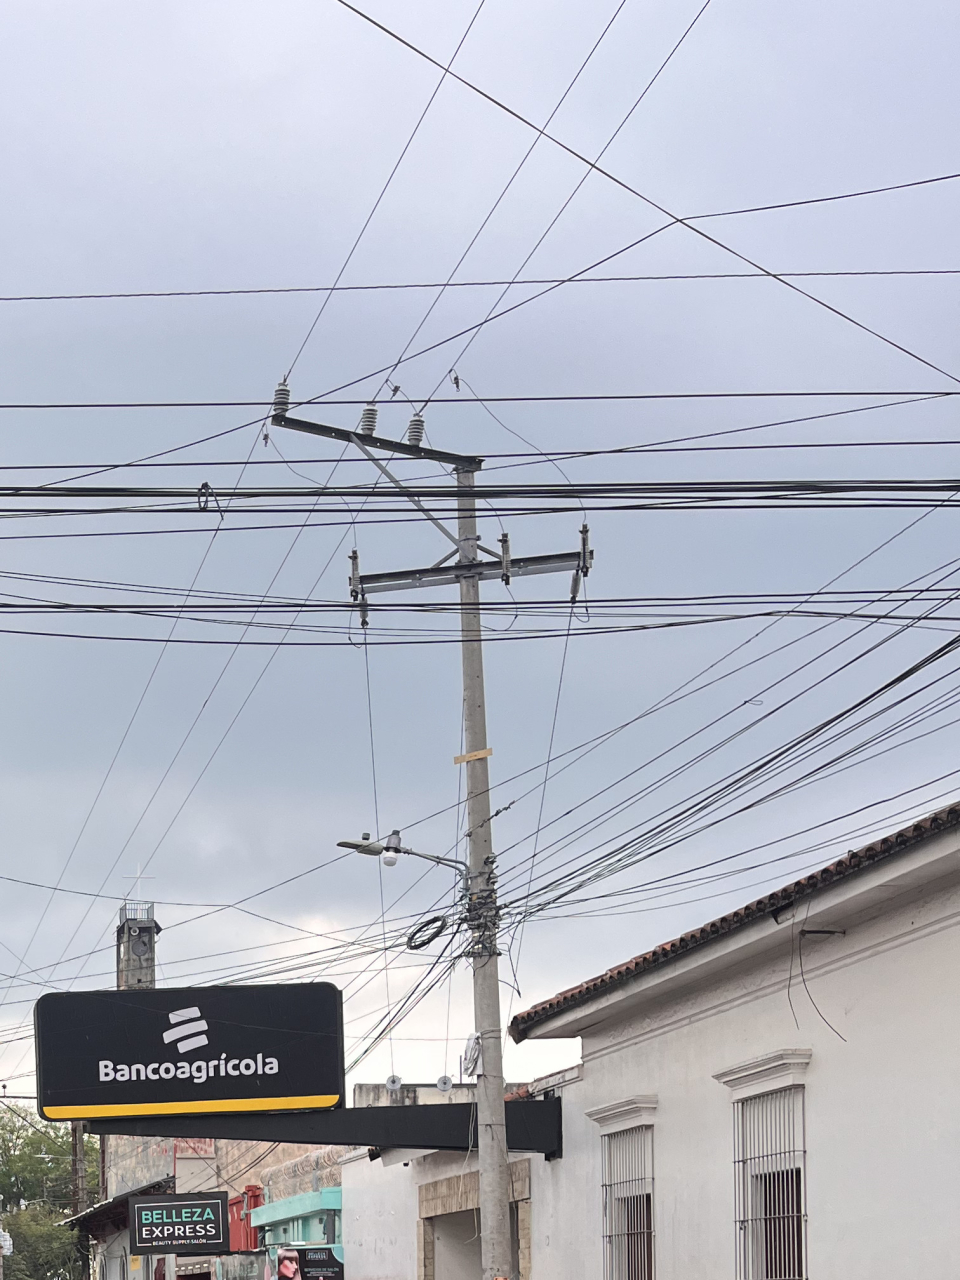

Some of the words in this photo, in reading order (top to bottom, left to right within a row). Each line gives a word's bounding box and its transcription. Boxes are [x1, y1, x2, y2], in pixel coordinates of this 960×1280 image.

[98, 1052, 279, 1084] Bancoagrícola
[141, 1207, 215, 1224] BELLEZA
[142, 1224, 216, 1239] EXPRESS
